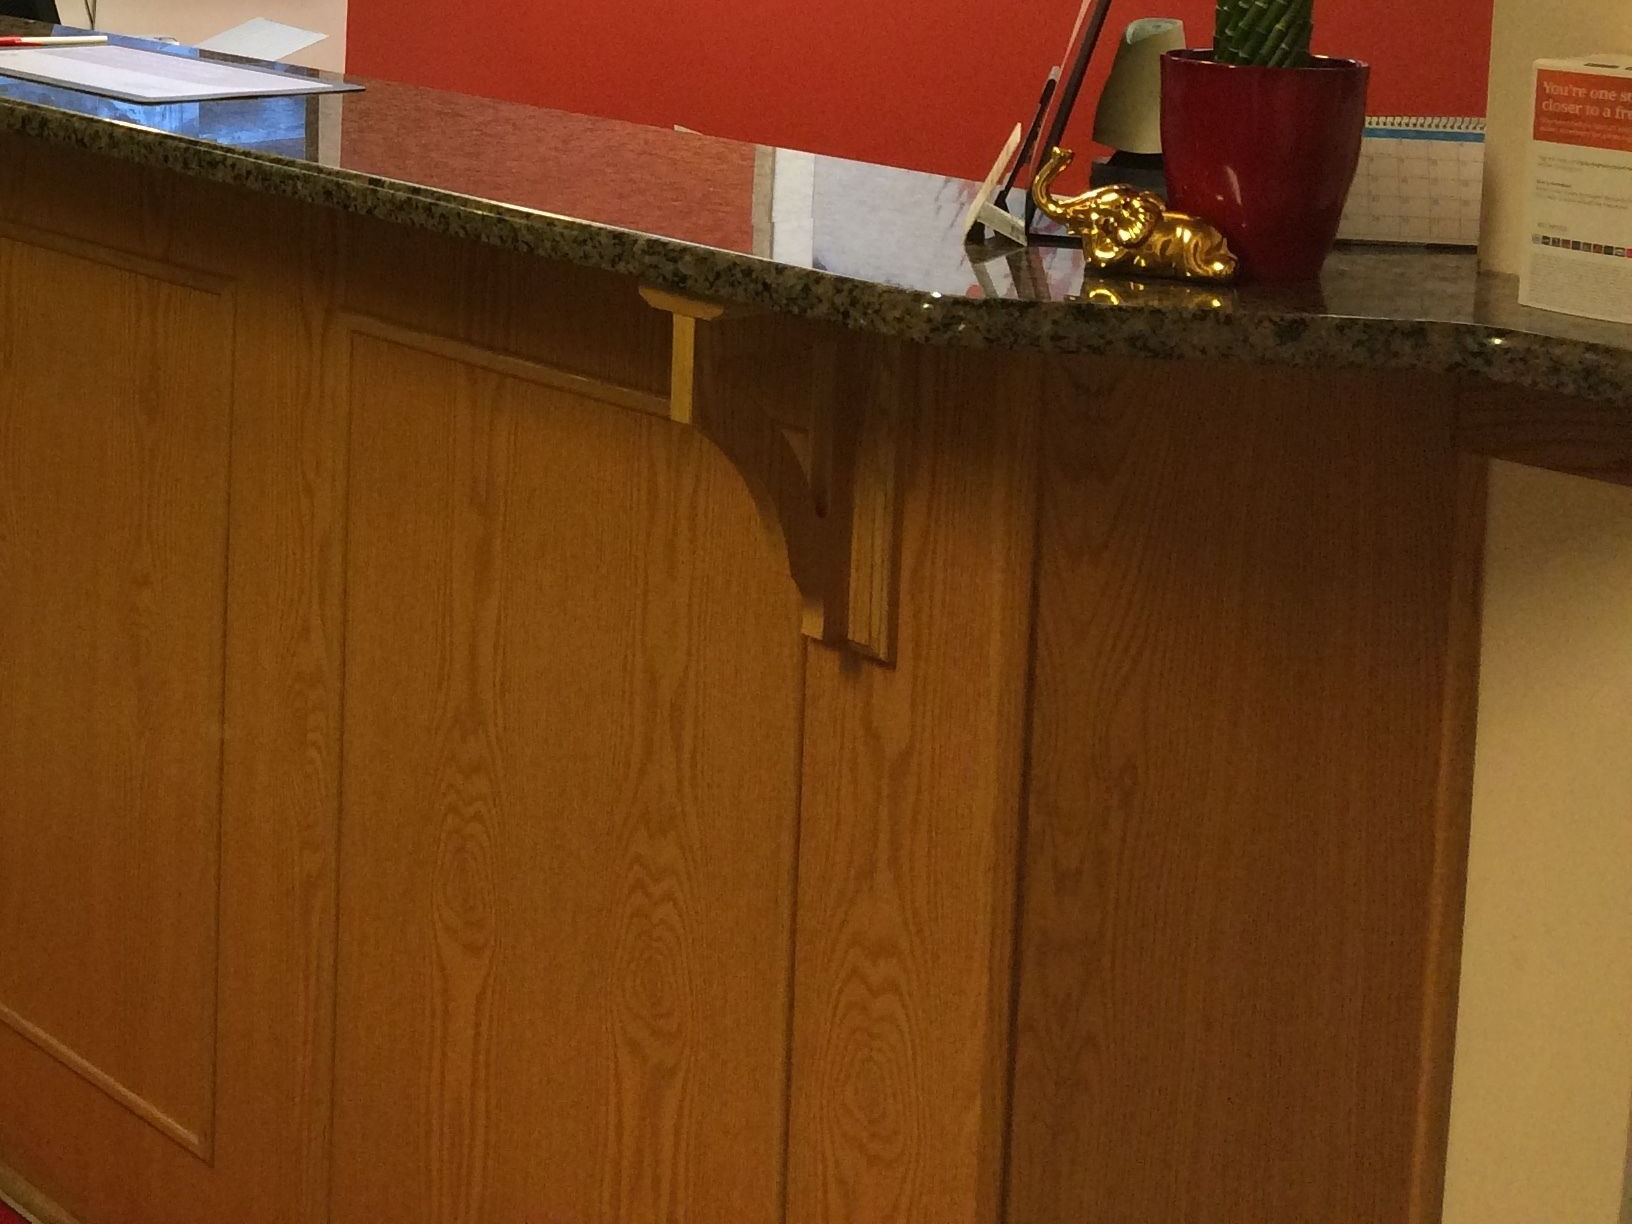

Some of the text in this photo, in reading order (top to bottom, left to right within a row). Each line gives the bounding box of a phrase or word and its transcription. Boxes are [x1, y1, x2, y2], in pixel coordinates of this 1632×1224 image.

[1543, 81, 1587, 97] You're
[1590, 89, 1617, 101] one
[1542, 98, 1582, 116] closer
[1585, 104, 1599, 116] to
[1602, 107, 1611, 118] a
